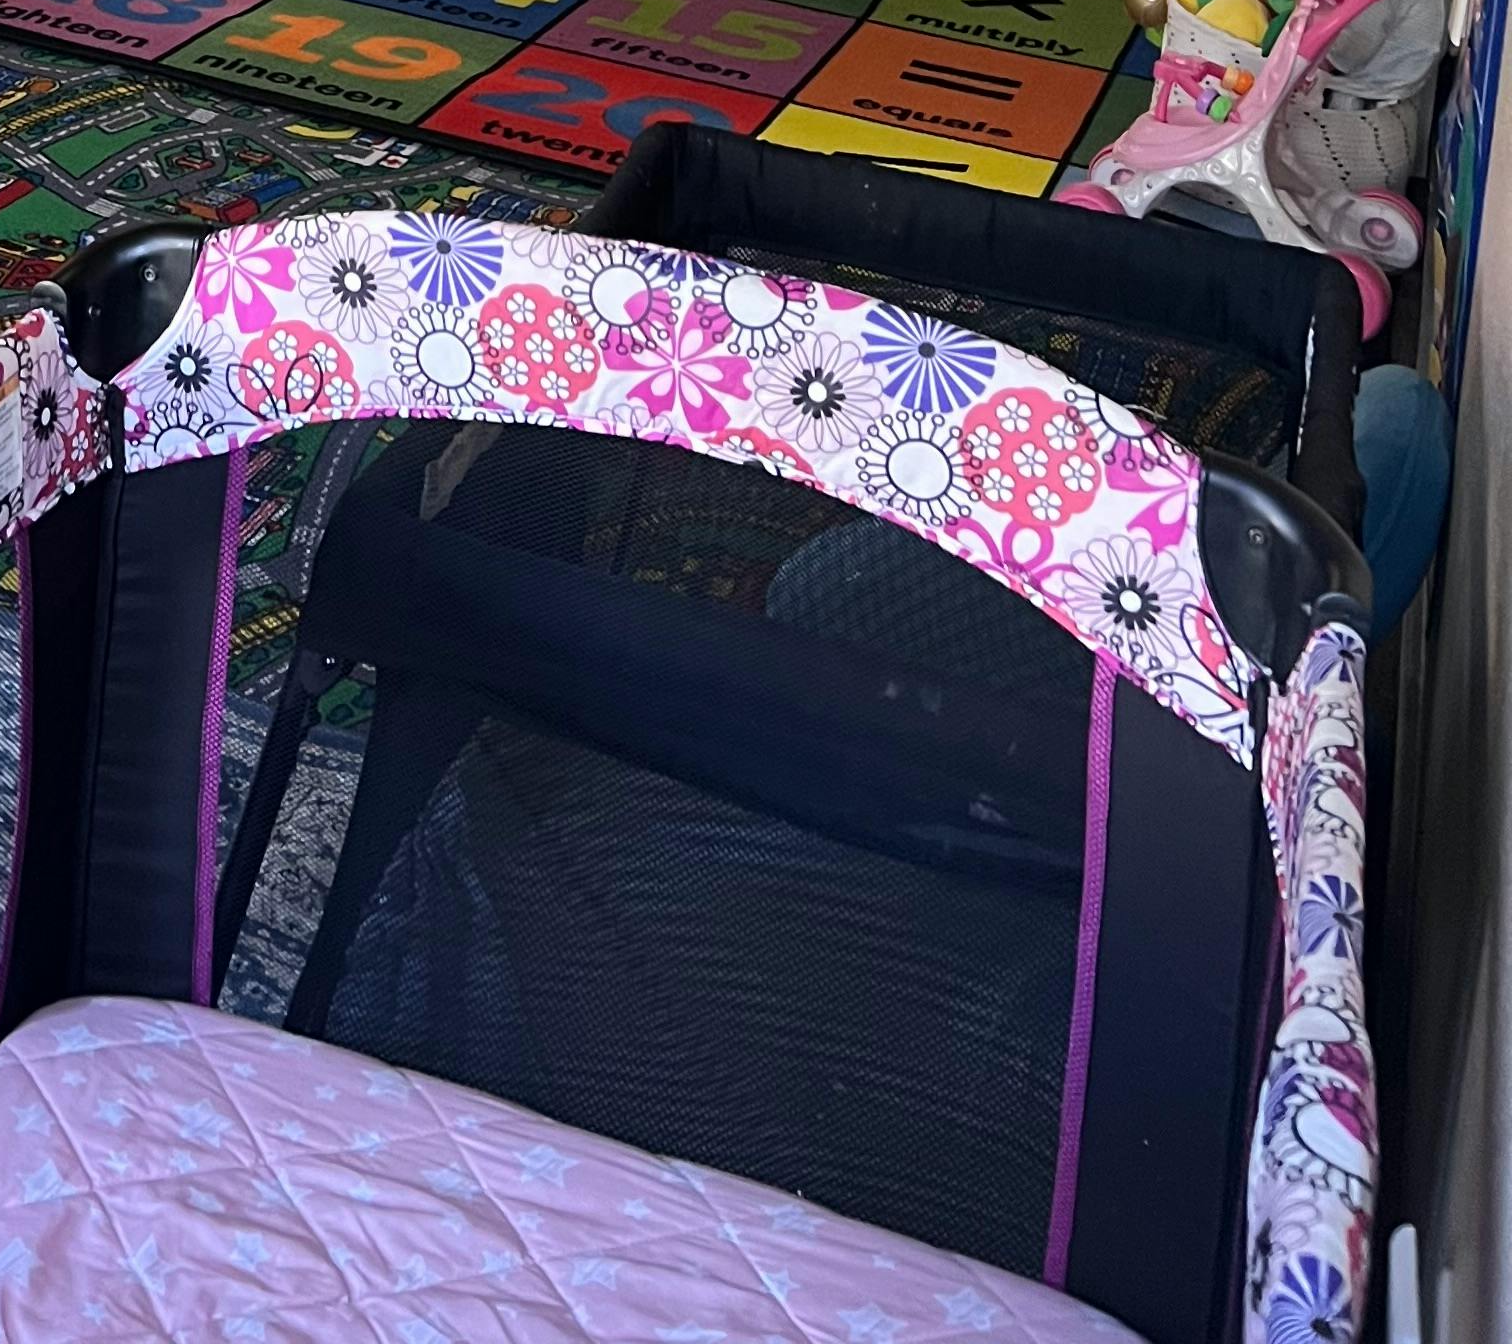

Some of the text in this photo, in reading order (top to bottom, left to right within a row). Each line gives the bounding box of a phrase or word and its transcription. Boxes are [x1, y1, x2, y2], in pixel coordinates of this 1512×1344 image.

[225, 14, 463, 82] 19
[591, 36, 751, 82] fifteen
[904, 12, 1084, 58] multiply
[193, 51, 405, 112] nineteen
[852, 97, 1013, 140] equals
[480, 120, 631, 172] twent
